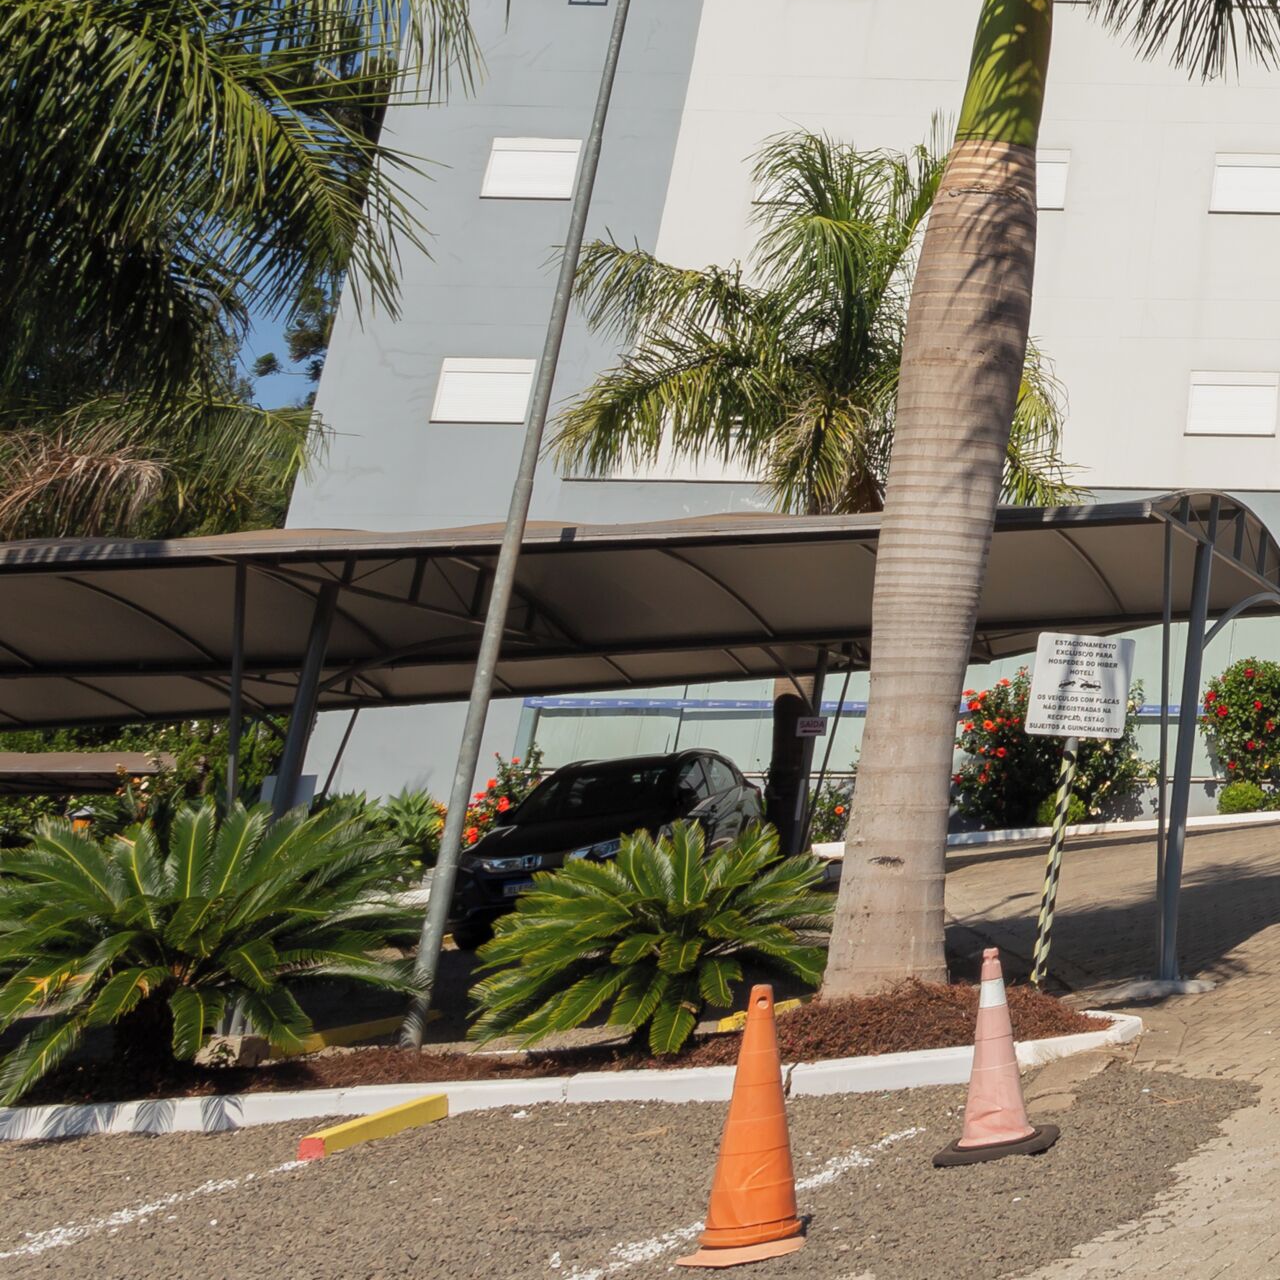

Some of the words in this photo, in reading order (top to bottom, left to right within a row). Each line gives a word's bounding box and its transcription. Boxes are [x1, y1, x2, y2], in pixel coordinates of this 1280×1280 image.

[1055, 639, 1117, 650] ESTACIONAMENTO
[1095, 651, 1113, 659] PARA
[1095, 697, 1120, 705] PLACAS
[1058, 705, 1101, 713] REGISTRADAS
[1029, 722, 1060, 730] SUJEITOS
